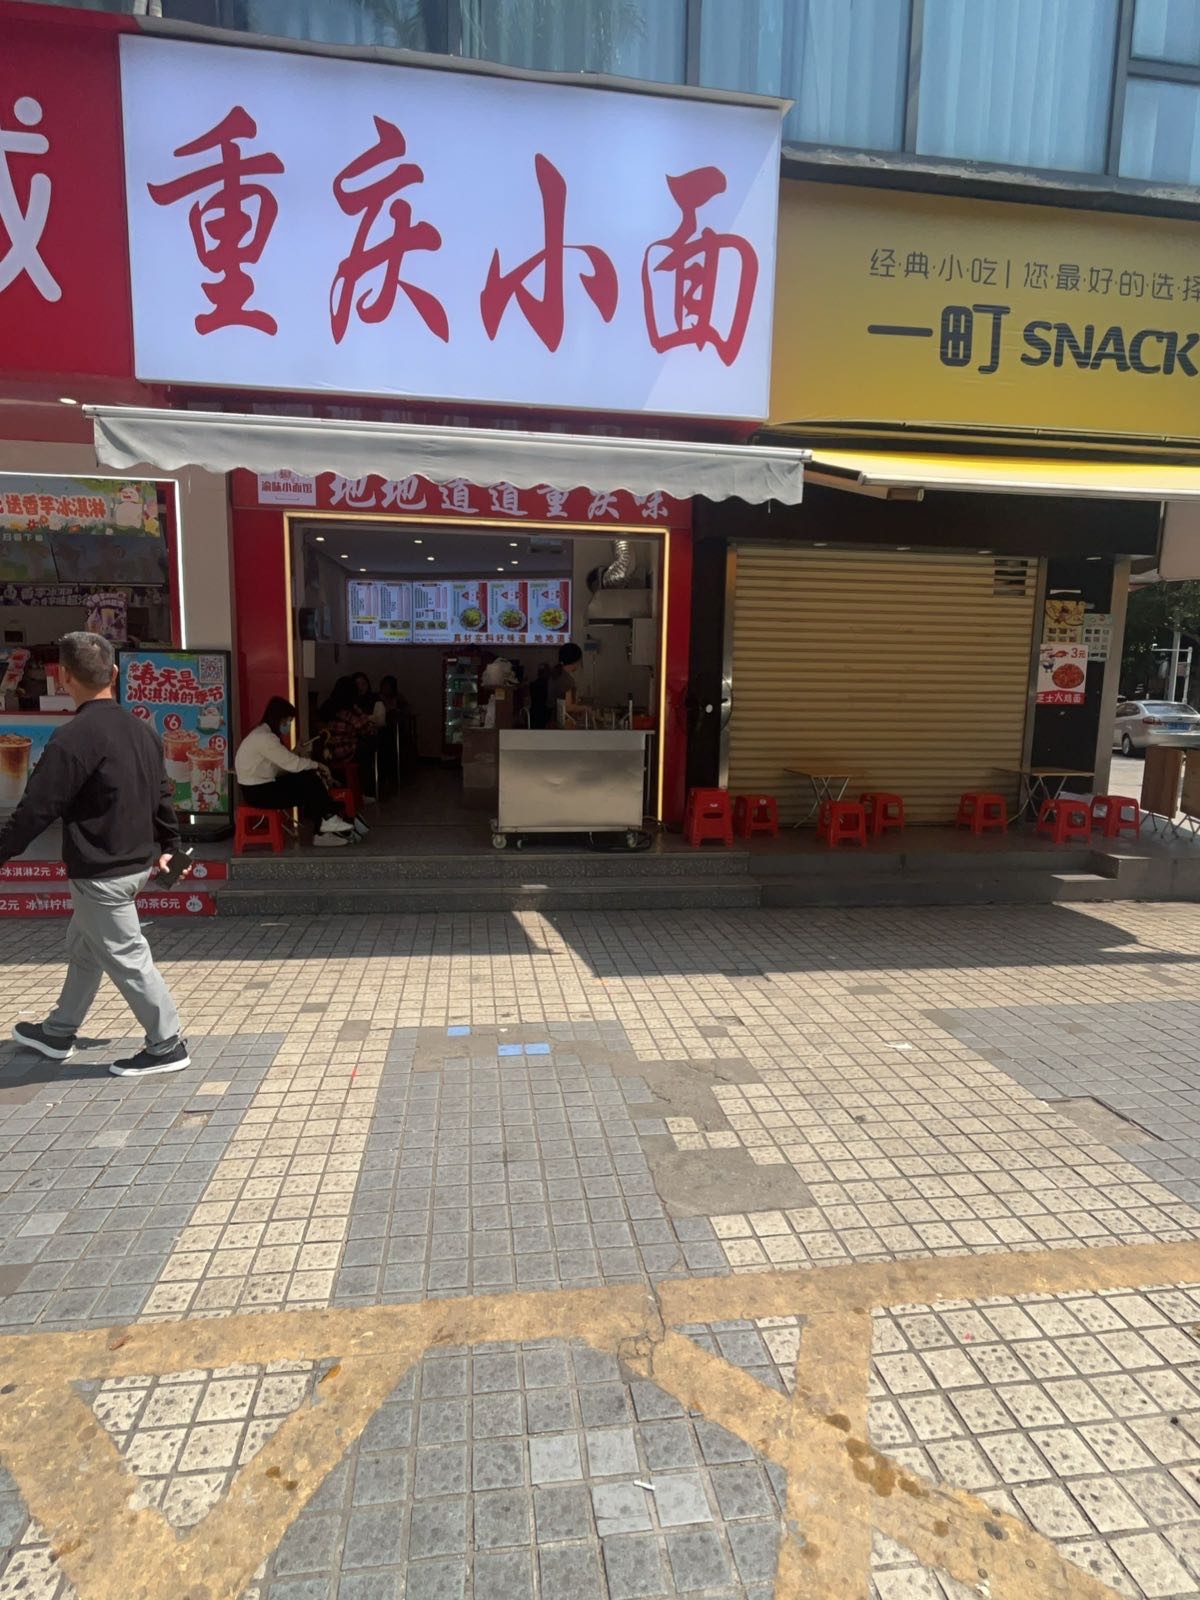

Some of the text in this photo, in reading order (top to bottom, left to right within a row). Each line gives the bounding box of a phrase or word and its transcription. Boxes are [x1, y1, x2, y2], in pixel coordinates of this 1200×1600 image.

[147, 105, 759, 367] 重庆小面
[867, 303, 1200, 377] 一町 SNACK
[132, 661, 200, 692] 春天是
[126, 684, 224, 705] 冰淇淋的季节
[136, 898, 181, 910] 奶茶6元
